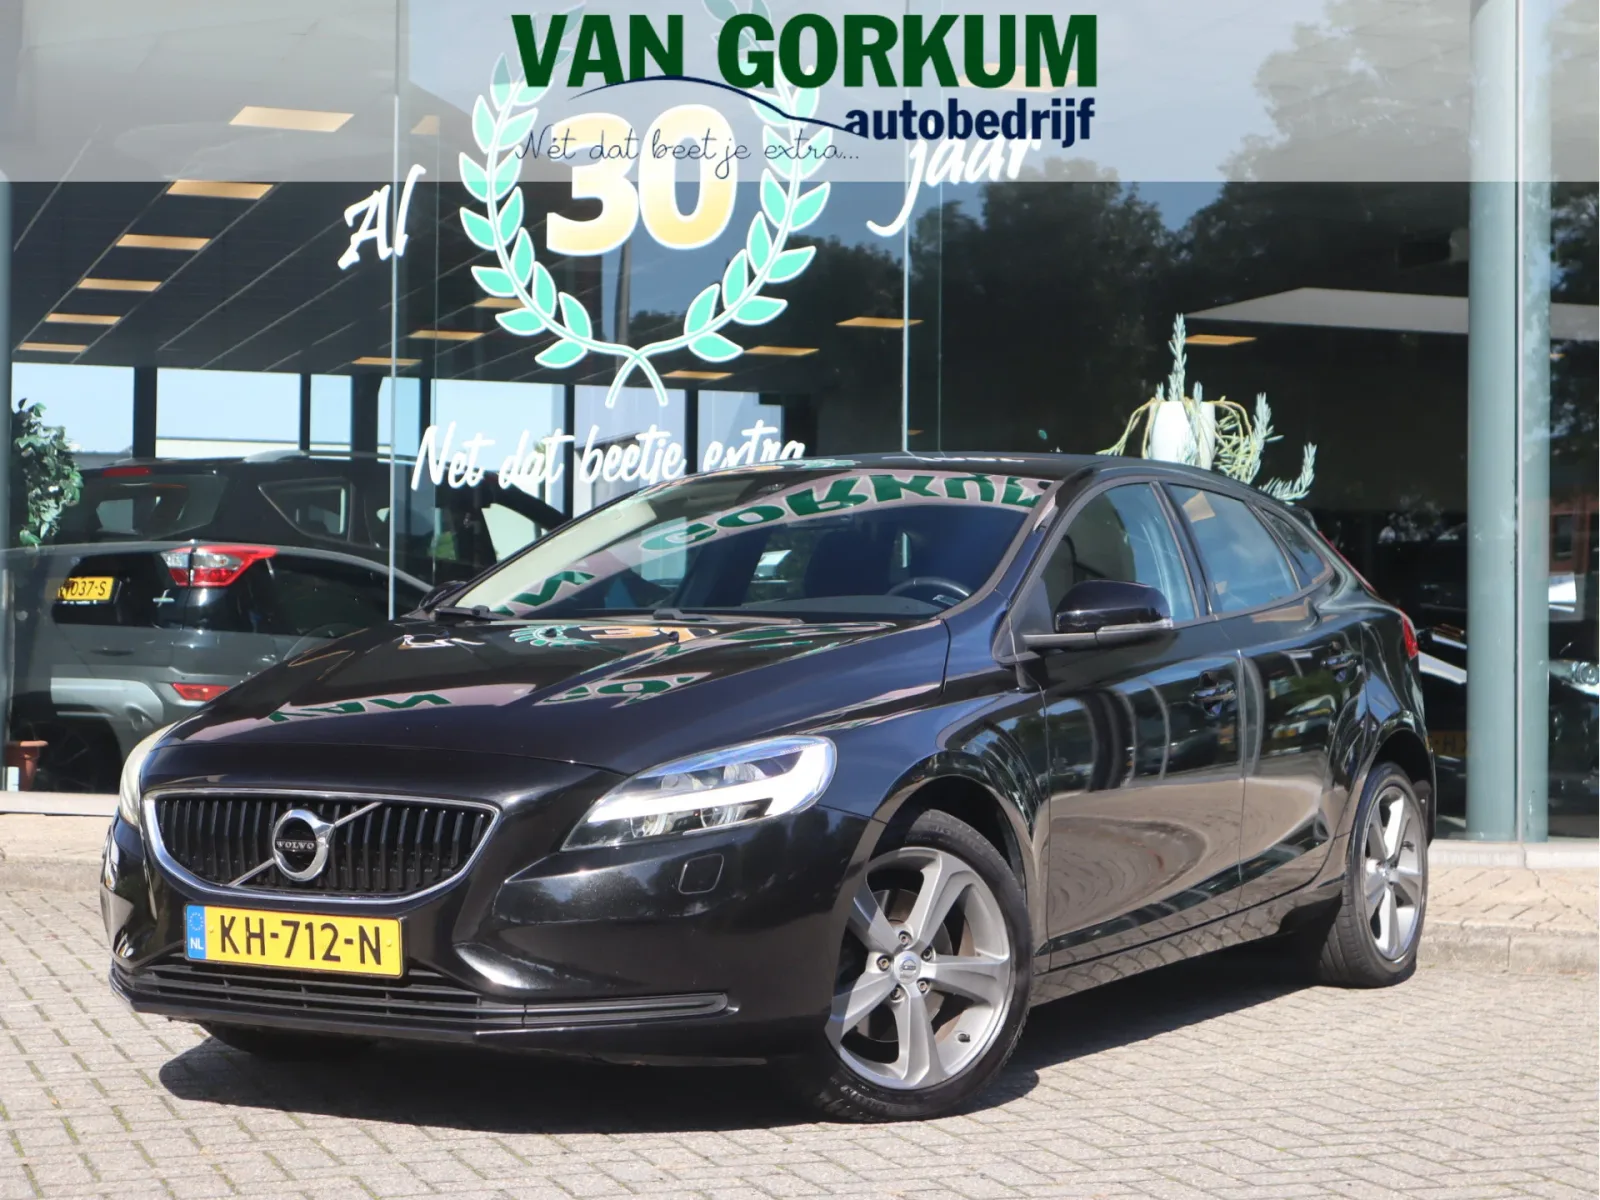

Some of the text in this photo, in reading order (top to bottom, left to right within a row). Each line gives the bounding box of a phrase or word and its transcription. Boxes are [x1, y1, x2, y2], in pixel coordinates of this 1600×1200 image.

[546, 103, 738, 256] 30
[866, 119, 1042, 237] jaar
[337, 164, 427, 270] Al
[411, 421, 496, 491] Net
[498, 429, 576, 490] dat
[579, 424, 687, 485] beetje
[276, 840, 315, 850] VOLVO
[189, 937, 204, 951] NL
[219, 914, 382, 966] KH-712-N
